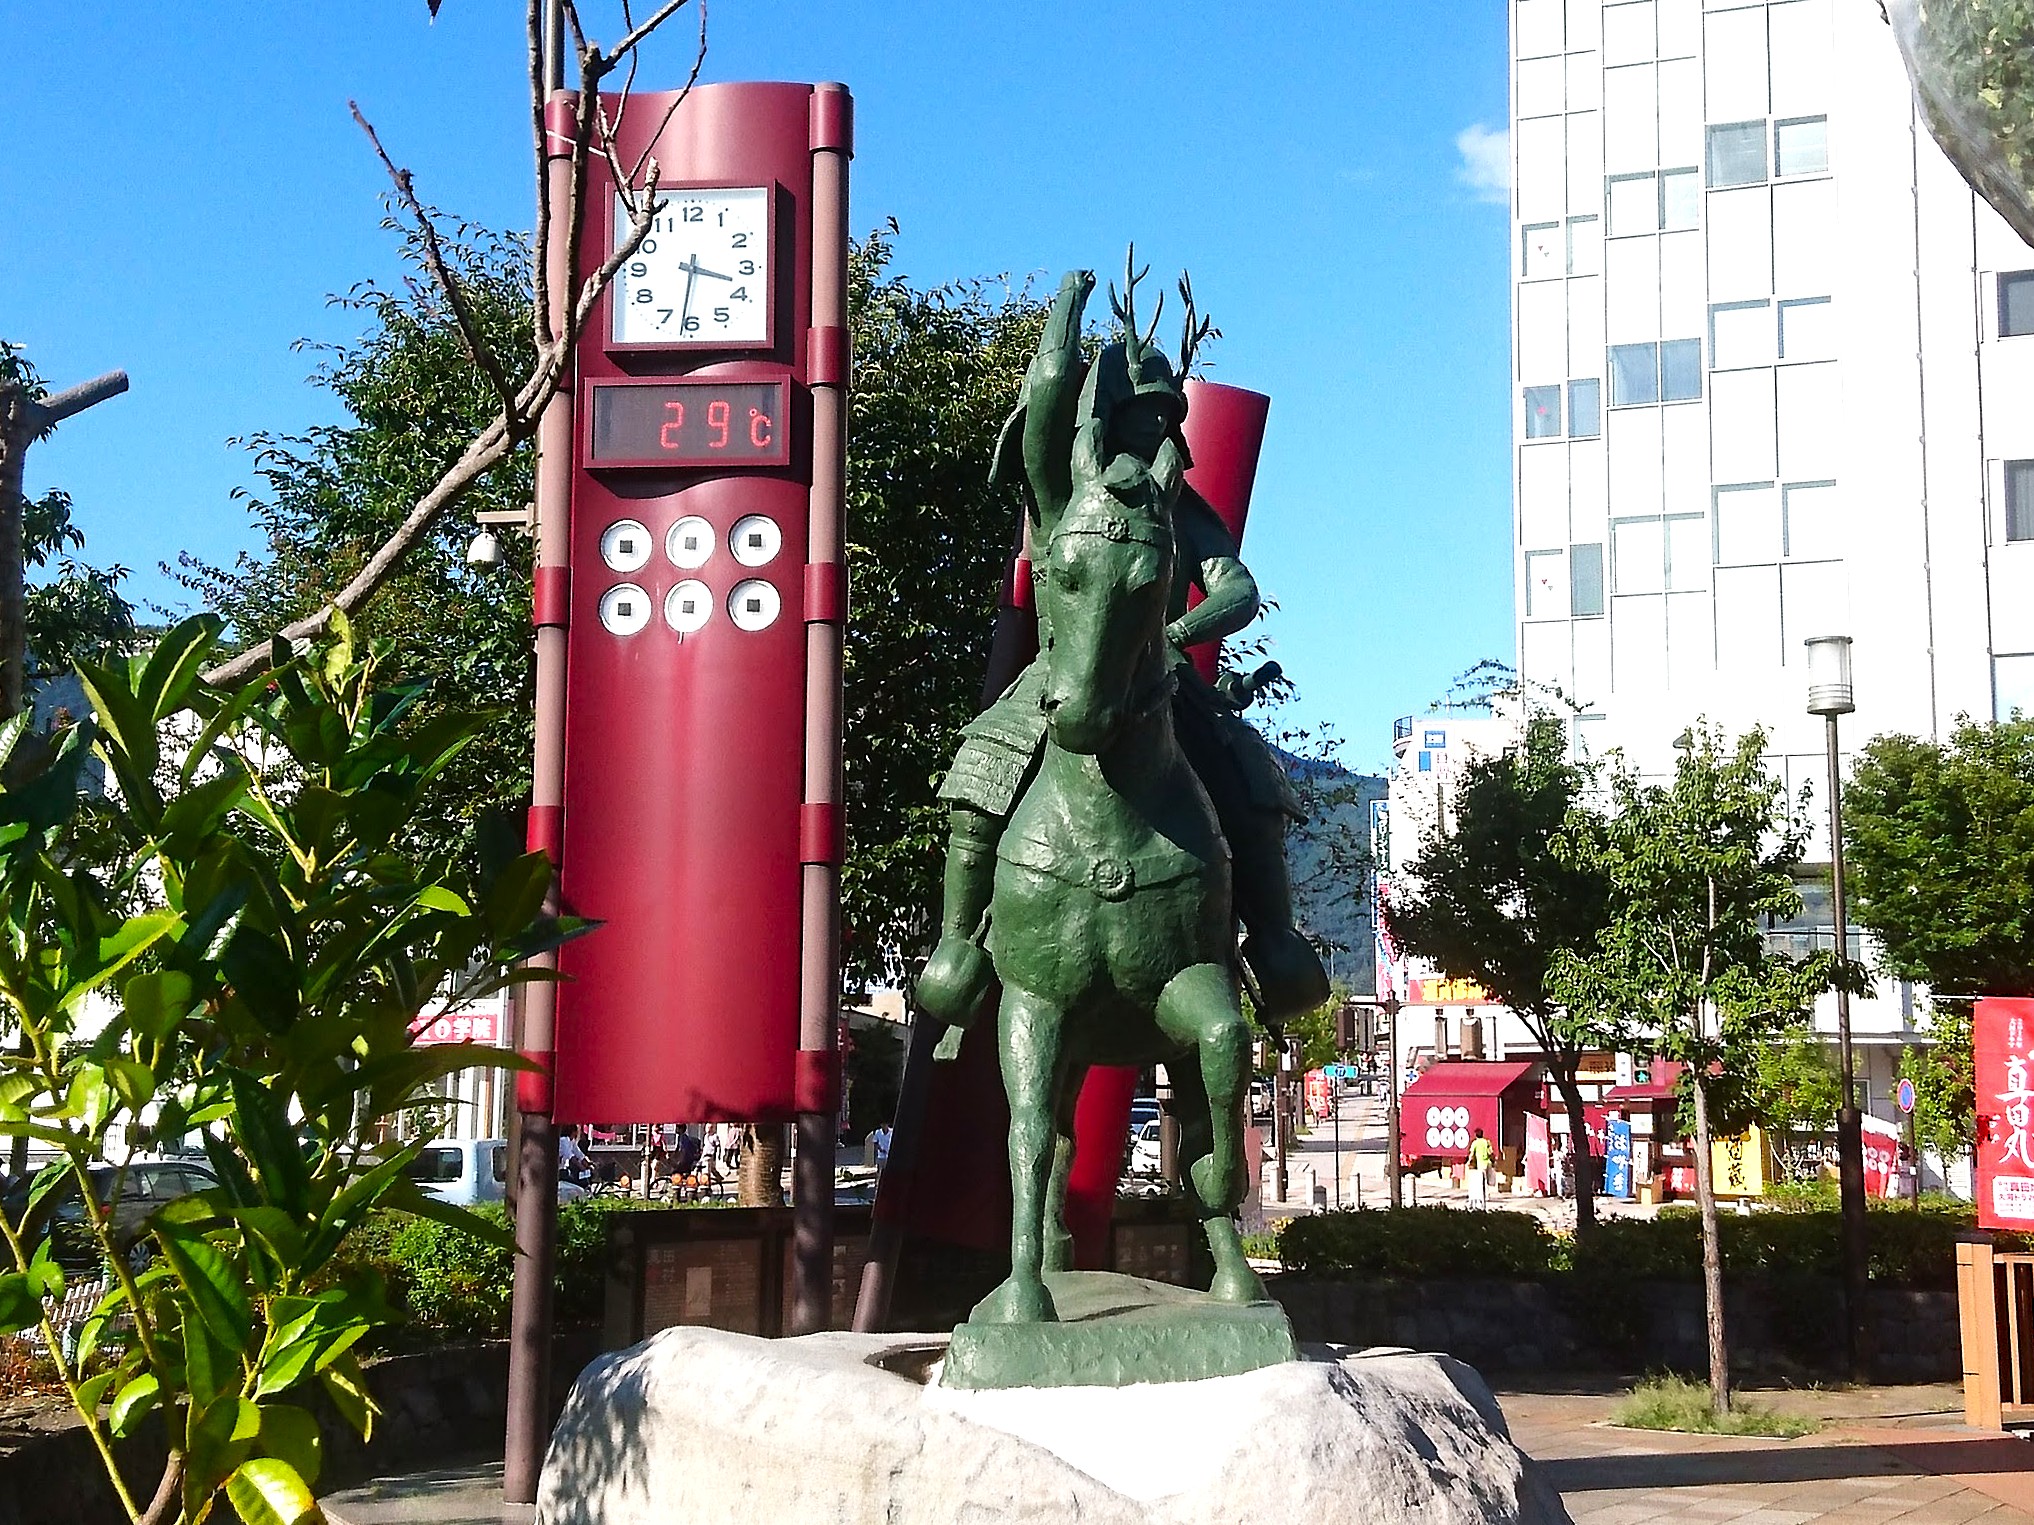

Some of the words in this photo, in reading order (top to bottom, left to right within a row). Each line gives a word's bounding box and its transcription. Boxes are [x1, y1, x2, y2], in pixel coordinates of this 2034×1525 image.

[682, 206, 704, 222] 12
[717, 212, 724, 227] 1
[656, 217, 674, 232] 11
[731, 233, 748, 248] 2
[630, 262, 647, 277] 9
[738, 260, 755, 275] 3
[636, 288, 653, 304] 8
[729, 286, 748, 301] 4
[656, 308, 674, 324] 7
[713, 307, 730, 322] 5
[684, 316, 700, 332] 6
